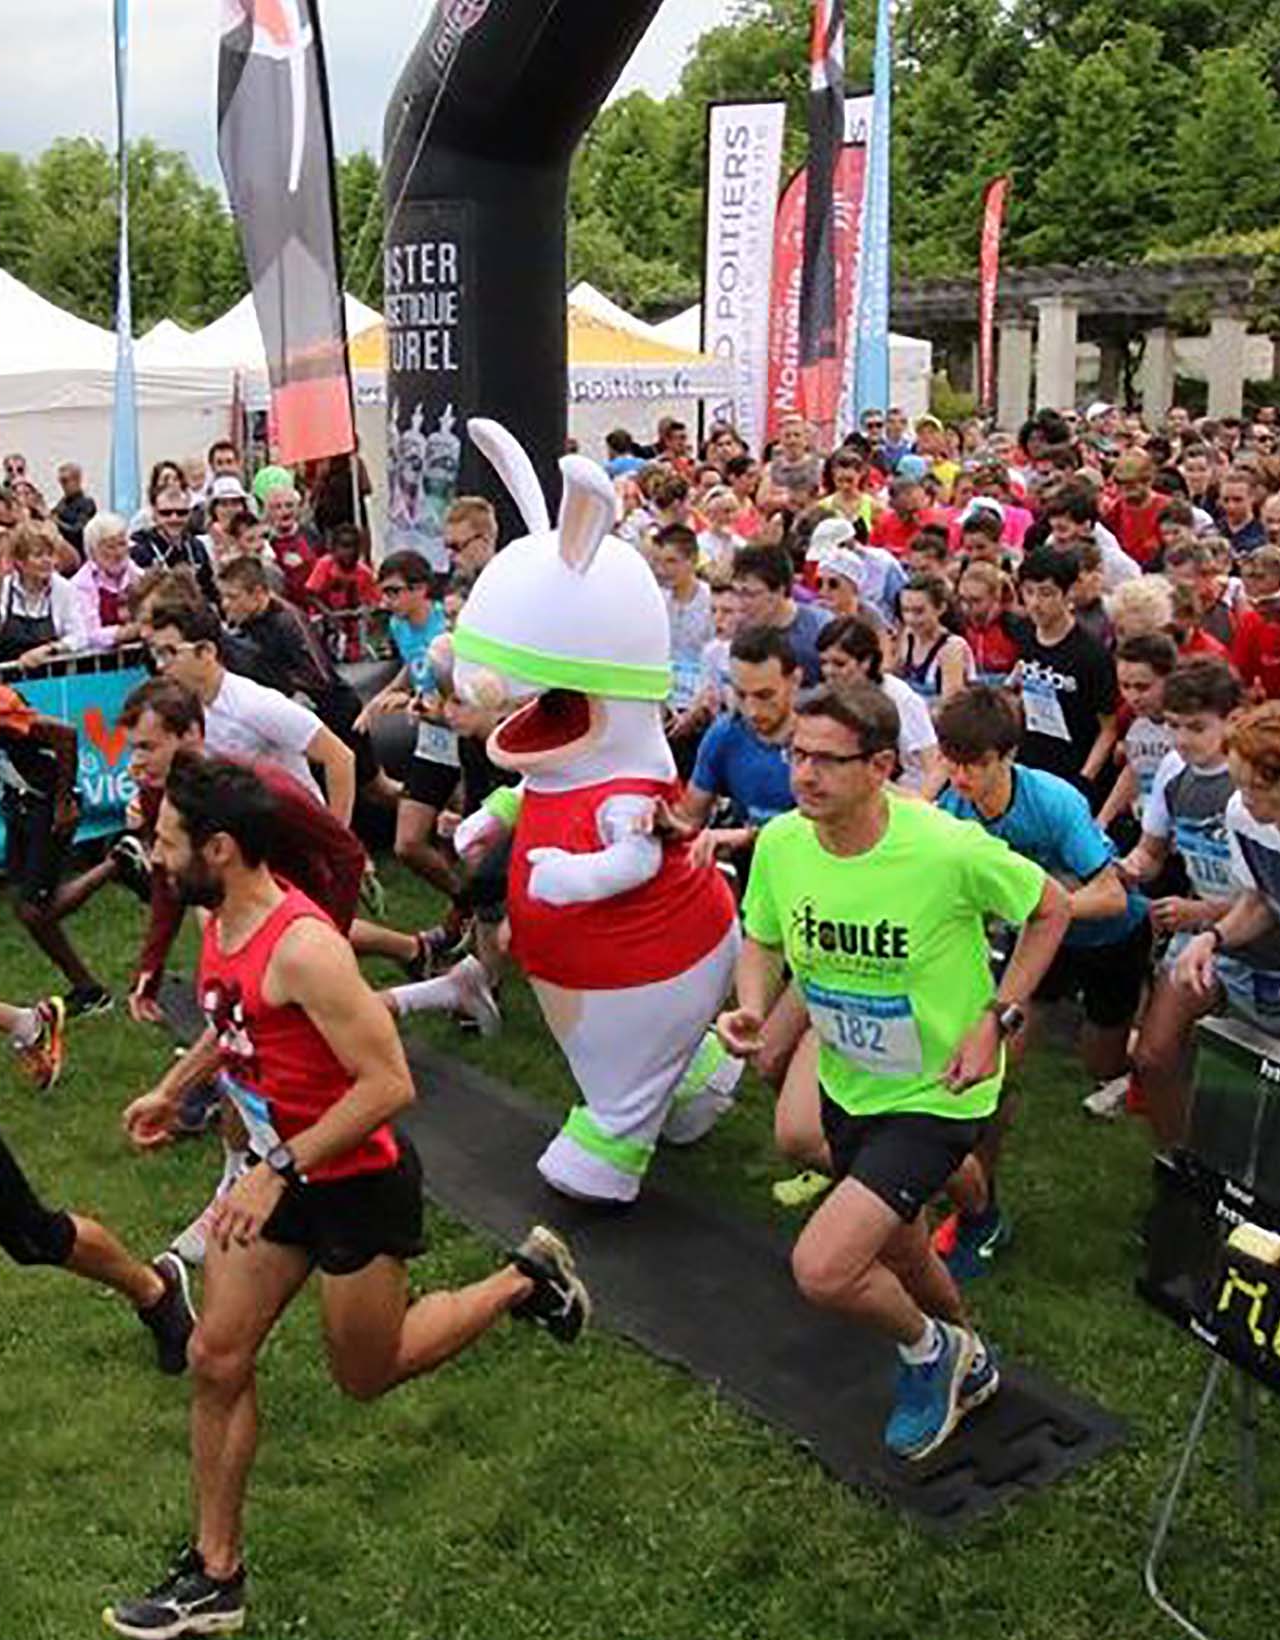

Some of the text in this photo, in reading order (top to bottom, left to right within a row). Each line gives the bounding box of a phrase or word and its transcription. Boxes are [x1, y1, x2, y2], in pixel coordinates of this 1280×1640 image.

[717, 125, 749, 319] POITIERS
[82, 771, 140, 806] vie
[835, 1013, 887, 1054] 182
